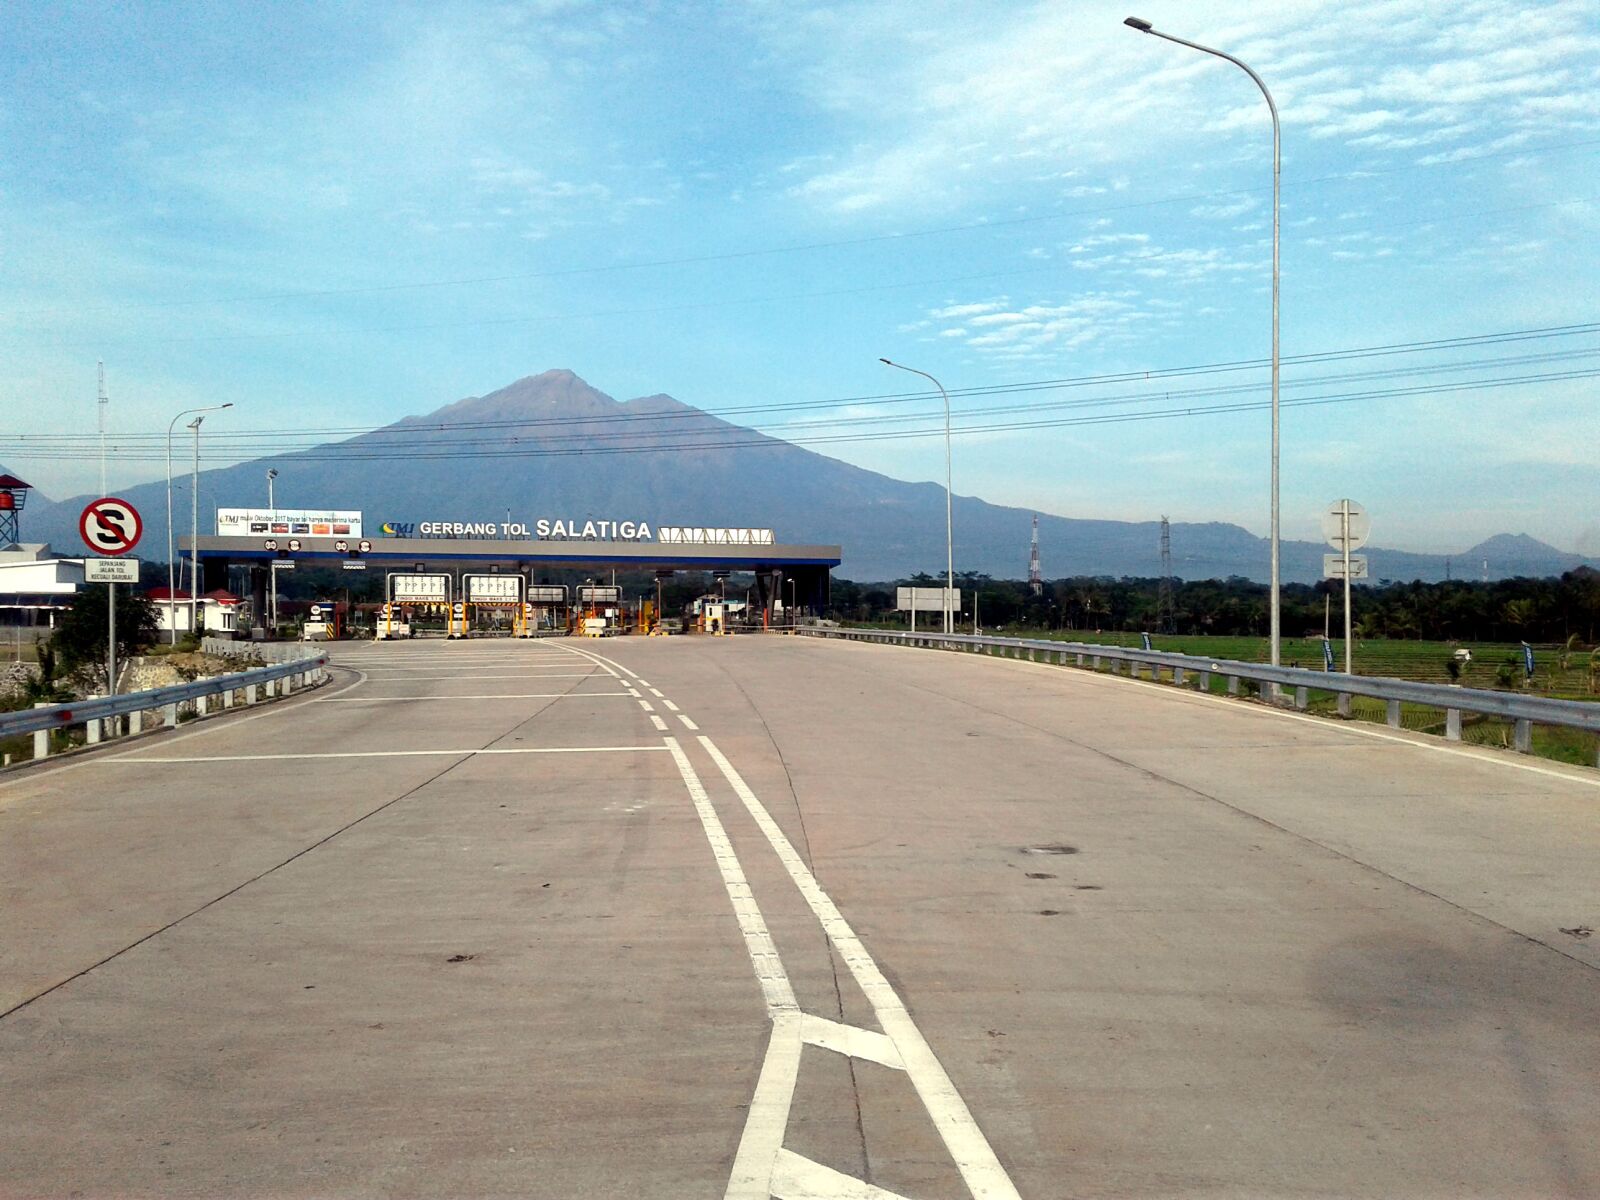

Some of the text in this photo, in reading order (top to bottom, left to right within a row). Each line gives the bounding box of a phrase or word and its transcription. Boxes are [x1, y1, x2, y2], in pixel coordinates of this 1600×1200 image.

[309, 516, 323, 524] hanya
[420, 522, 497, 535] GERBANG
[500, 523, 531, 535] TOL
[536, 519, 652, 538] SALATIGA
